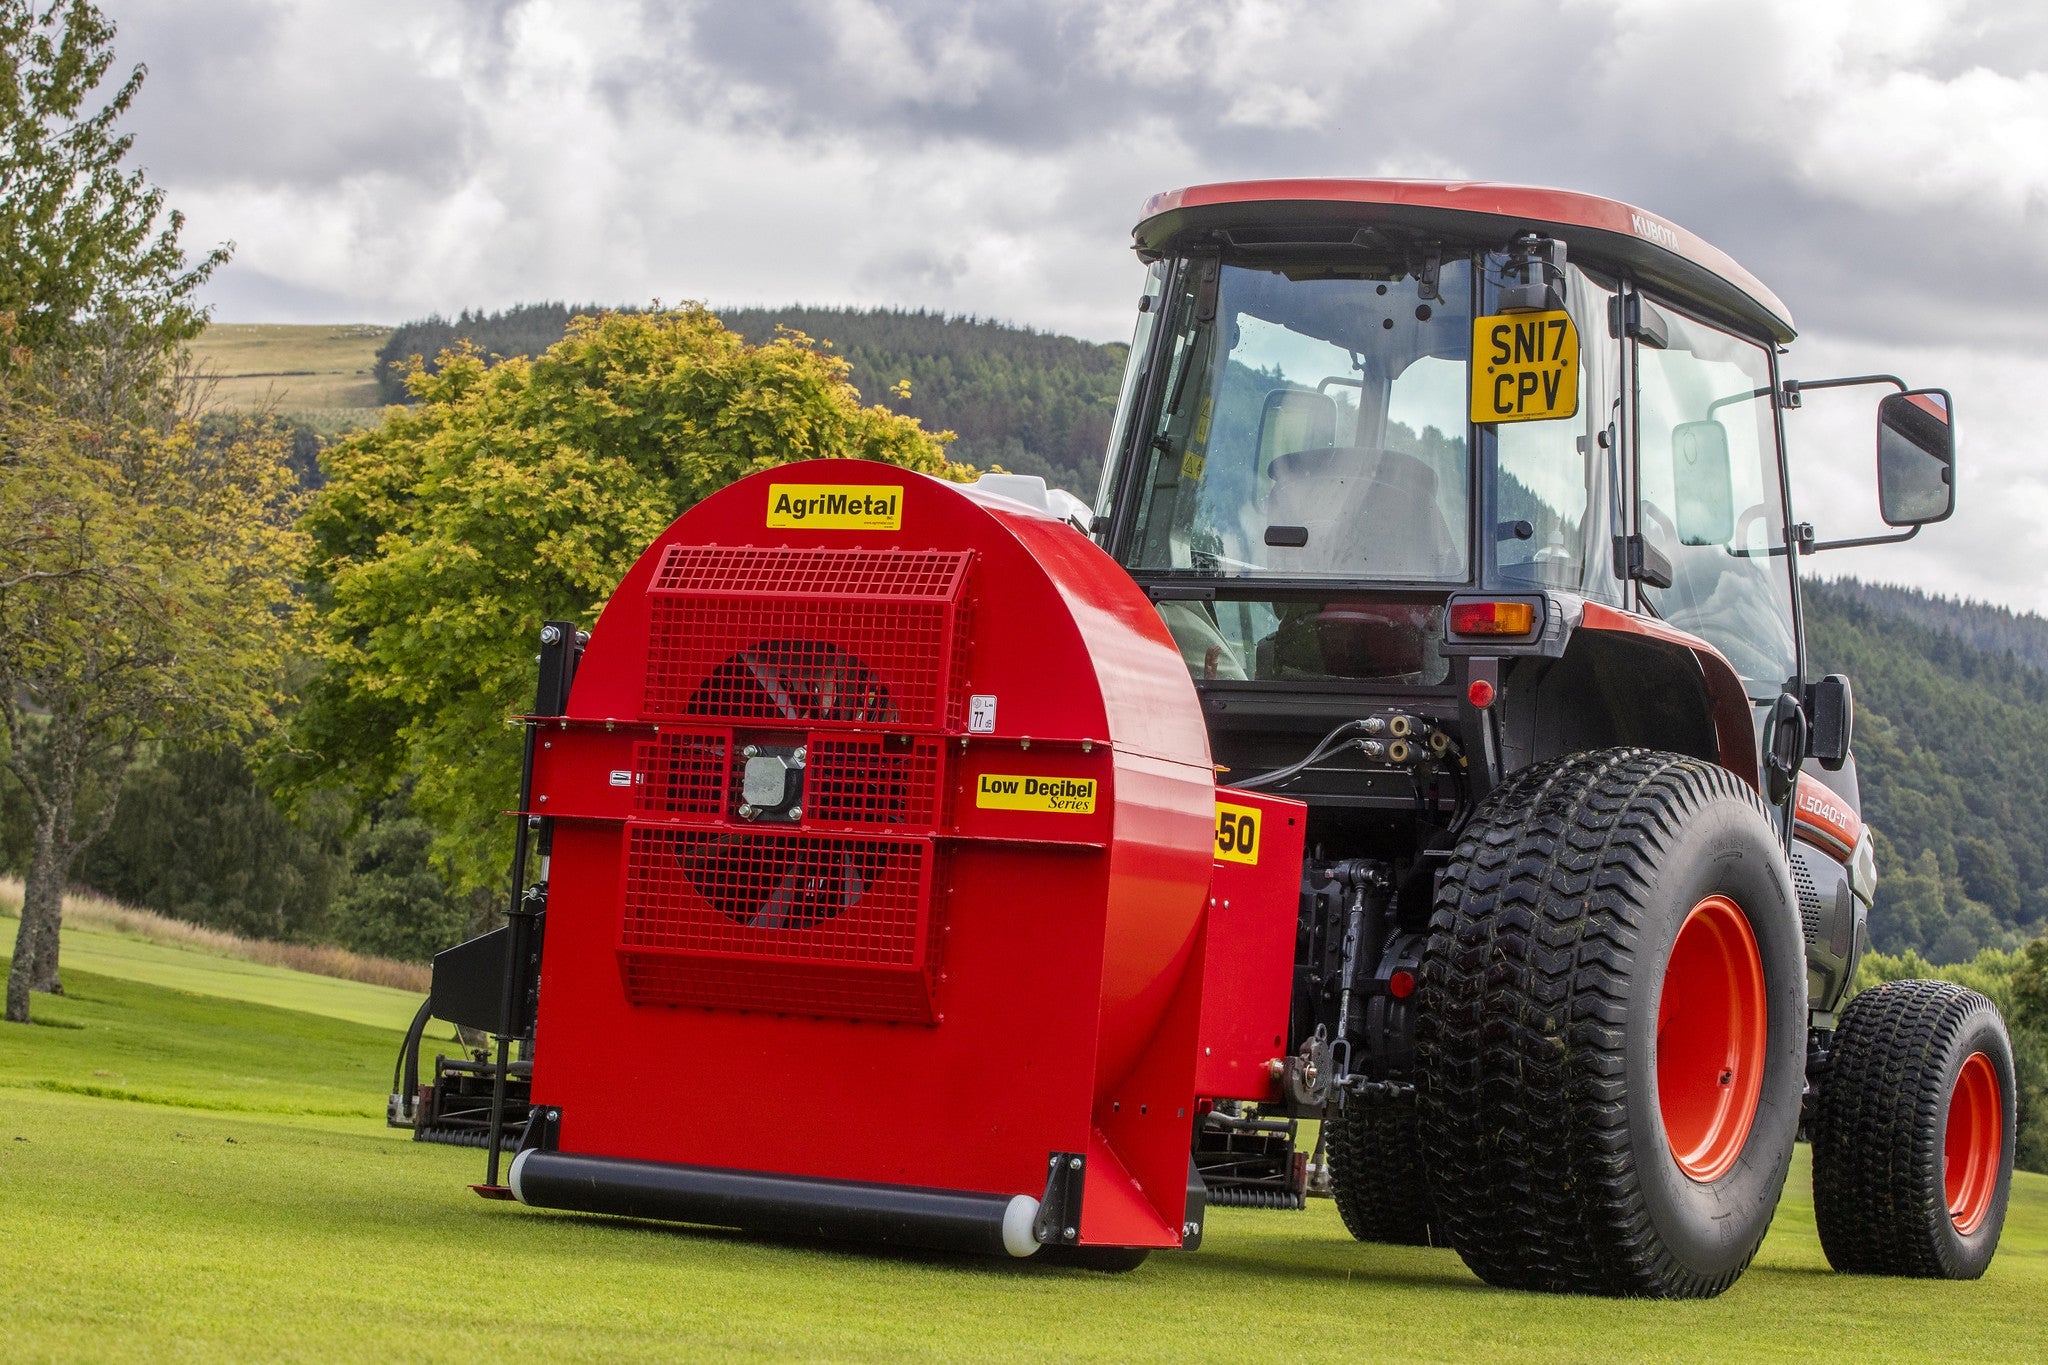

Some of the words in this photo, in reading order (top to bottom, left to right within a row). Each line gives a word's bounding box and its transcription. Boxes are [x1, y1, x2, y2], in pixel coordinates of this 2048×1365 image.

[1631, 213, 1680, 251] KUBOTA
[1491, 319, 1568, 366] SN17
[1493, 369, 1562, 414] CPV
[774, 493, 897, 520] AgriMetal
[974, 711, 984, 728] 77
[981, 776, 1019, 794] Low
[1024, 779, 1093, 798] Decibel
[1048, 796, 1090, 811] Series
